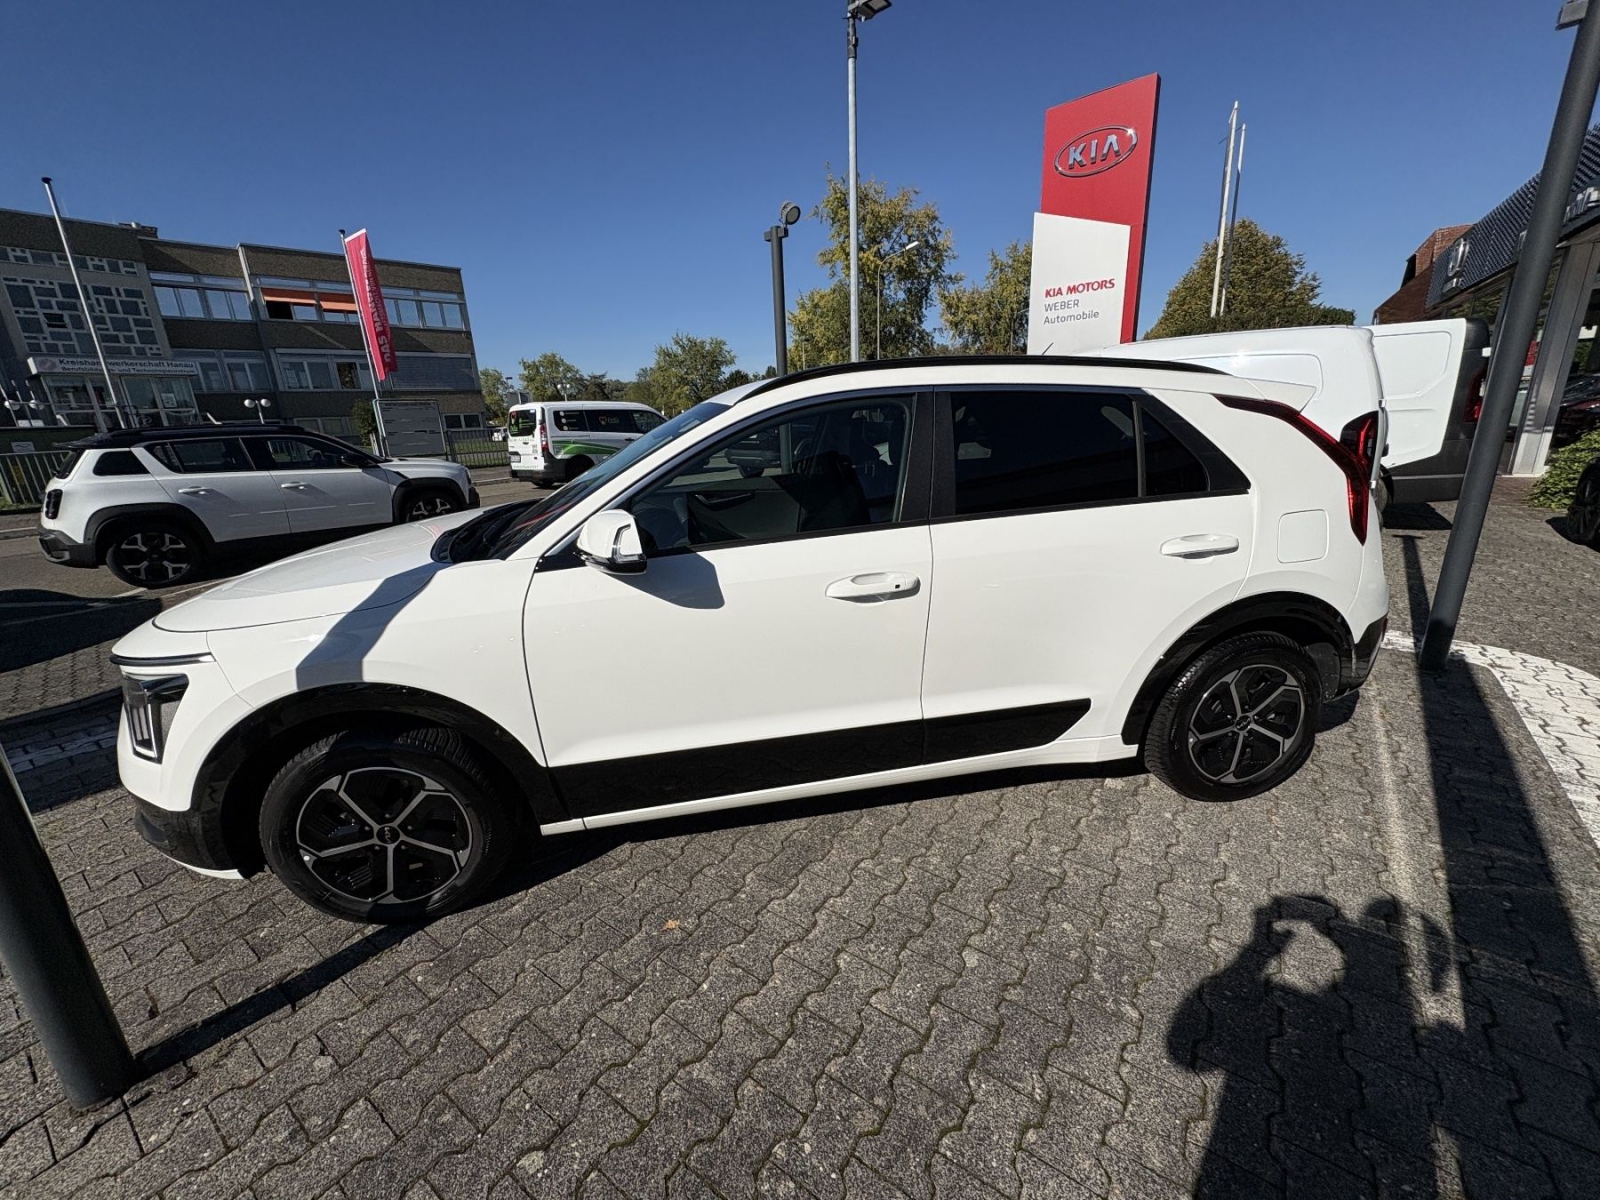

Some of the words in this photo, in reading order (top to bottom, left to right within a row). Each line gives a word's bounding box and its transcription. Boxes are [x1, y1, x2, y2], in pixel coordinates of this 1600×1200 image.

[1068, 134, 1121, 170] KIA
[1045, 287, 1063, 298] KIA
[1066, 278, 1115, 295] MOTORS
[1044, 299, 1080, 312] WEBER
[1043, 309, 1100, 325] Automobile
[58, 358, 165, 368] Kreishanwerkerschaft
